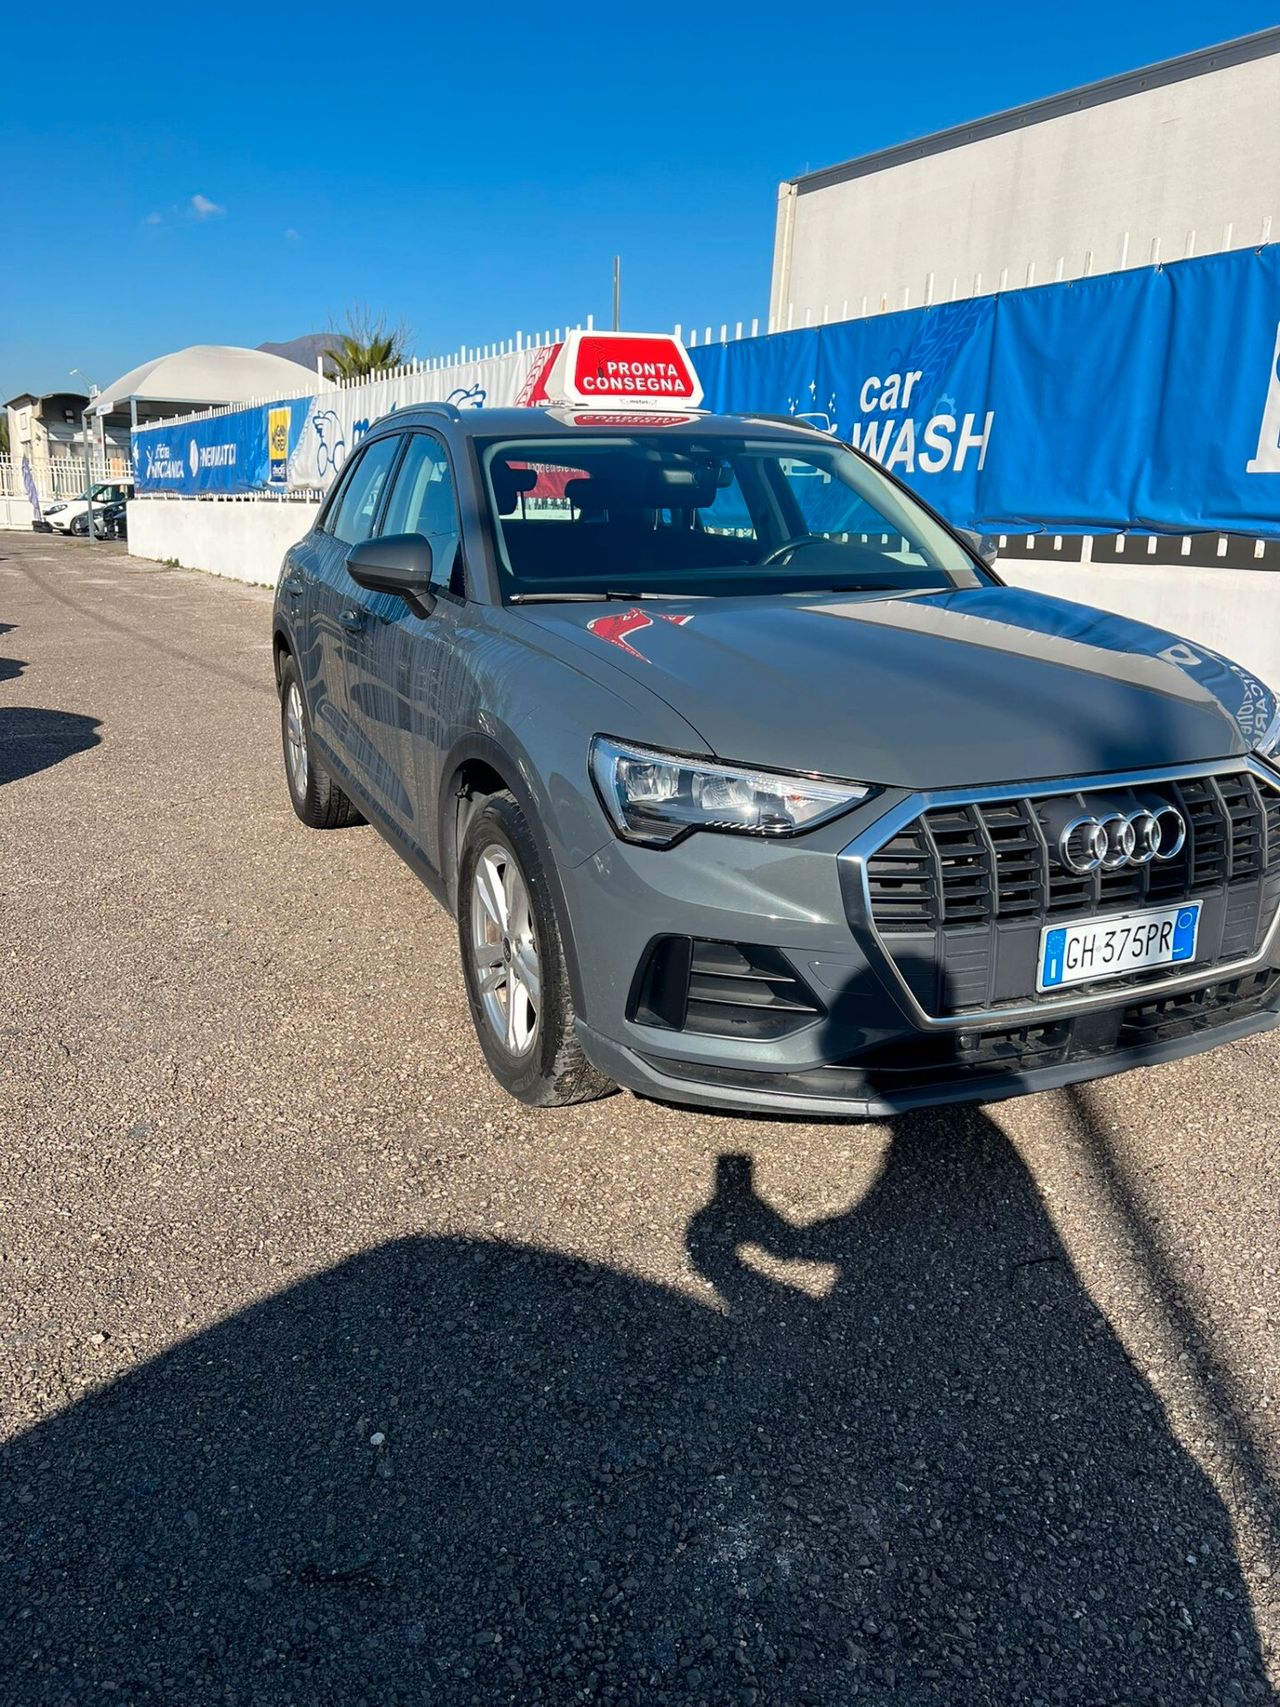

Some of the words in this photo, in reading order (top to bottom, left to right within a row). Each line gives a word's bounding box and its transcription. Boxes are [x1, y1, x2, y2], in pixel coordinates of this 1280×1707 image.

[607, 361, 678, 377] PRONTA
[582, 376, 685, 392] CONSEGNA
[859, 370, 923, 413] car
[851, 410, 995, 473] WASH
